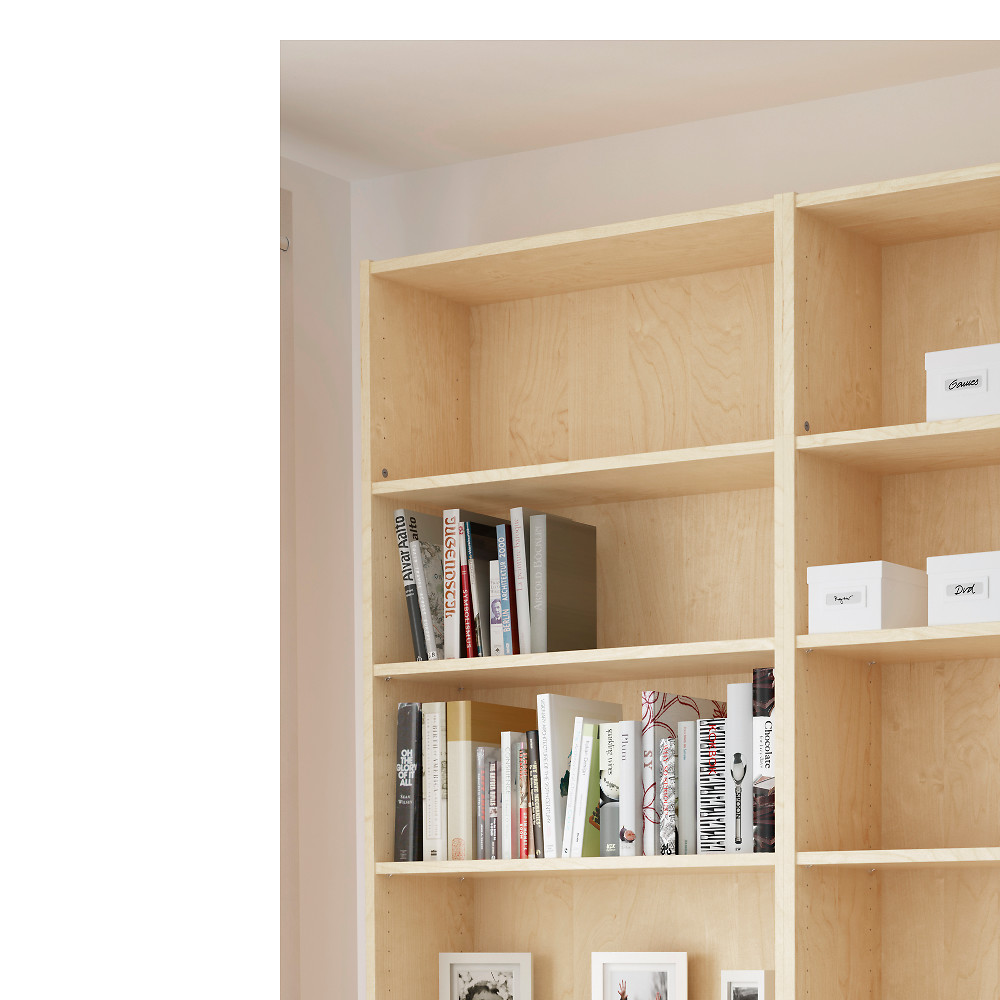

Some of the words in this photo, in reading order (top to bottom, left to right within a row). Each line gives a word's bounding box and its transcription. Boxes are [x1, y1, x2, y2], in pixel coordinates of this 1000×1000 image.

[948, 377, 979, 390] Games
[396, 516, 409, 549] Aalto
[497, 536, 506, 558] 2000
[401, 549, 413, 581] Alvar
[445, 516, 457, 619] JUGENDSTIL
[500, 561, 510, 602] ARCHITEKTUR
[503, 608, 511, 632] BERLIN
[401, 749, 413, 757] OH
[708, 724, 717, 775] KOKBOK
[764, 720, 772, 769] Chocolate
[396, 763, 417, 771] GLORY
[400, 756, 413, 764] THE
[398, 771, 408, 779] OF
[400, 779, 413, 787] ALL
